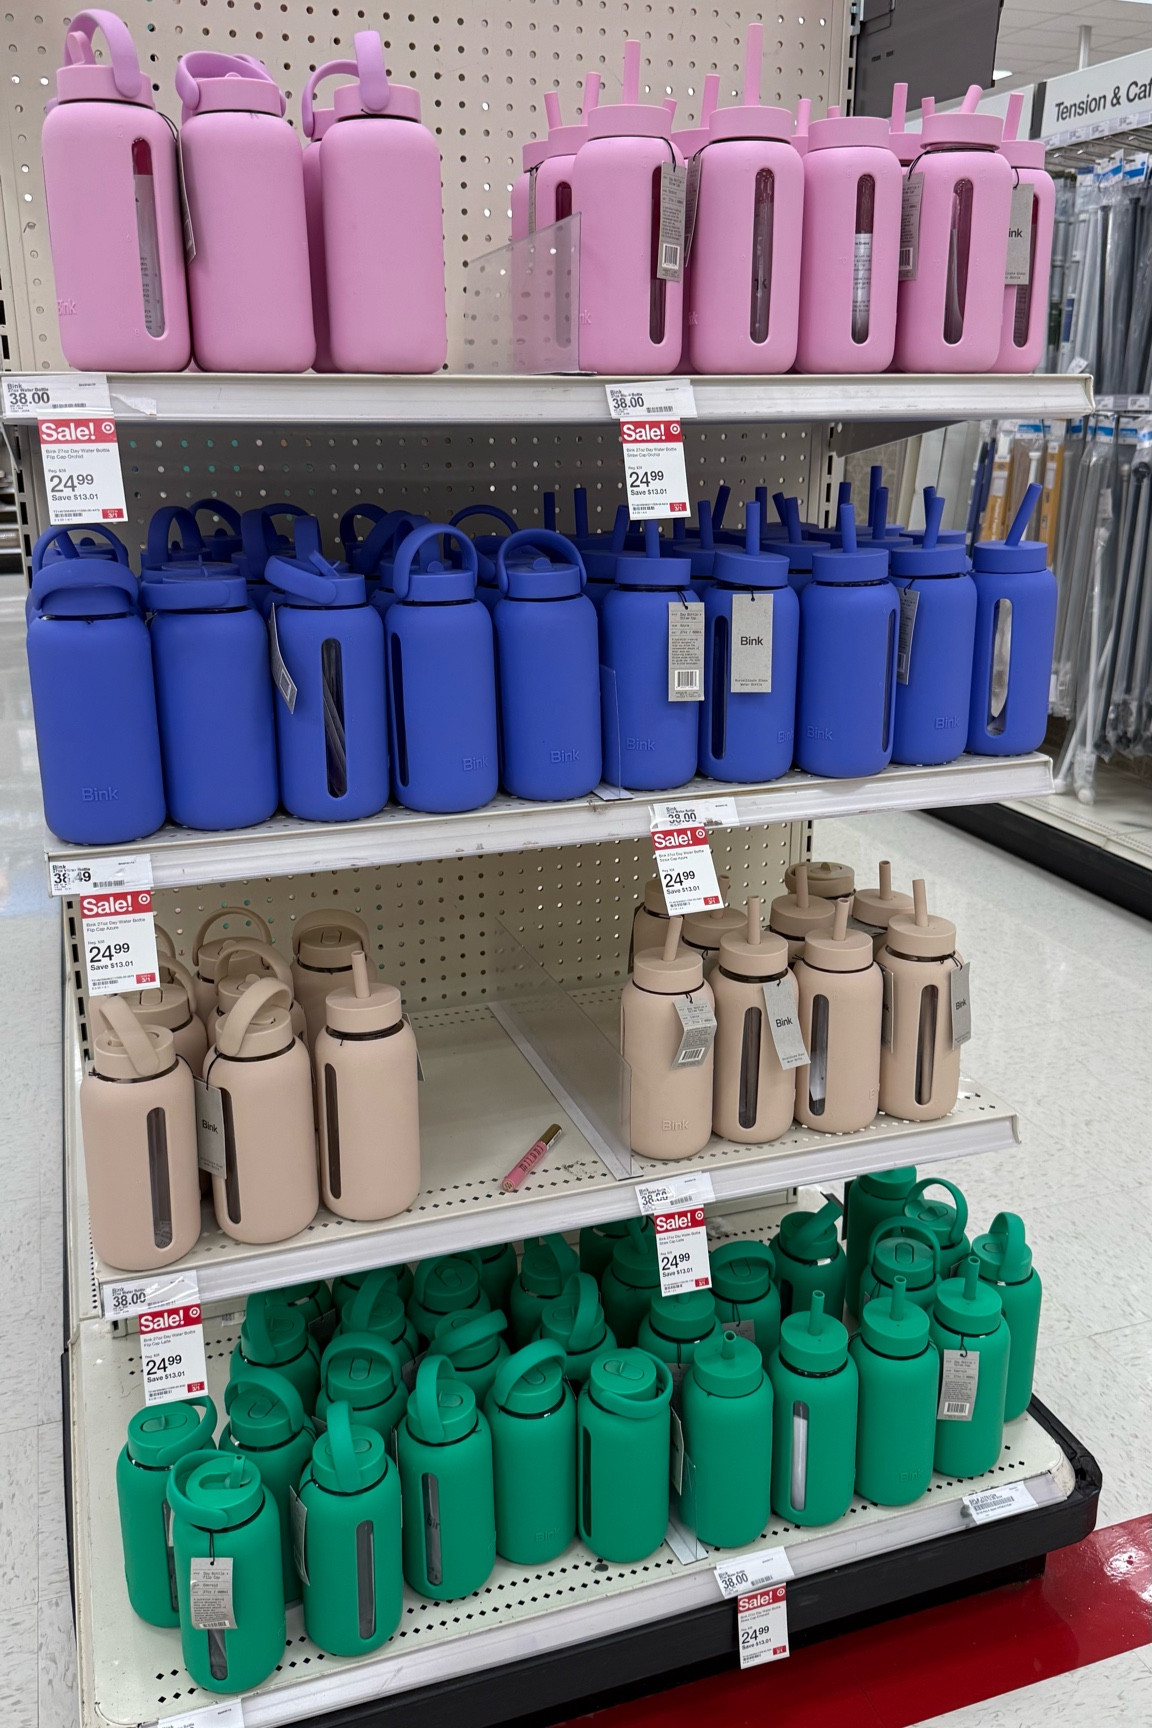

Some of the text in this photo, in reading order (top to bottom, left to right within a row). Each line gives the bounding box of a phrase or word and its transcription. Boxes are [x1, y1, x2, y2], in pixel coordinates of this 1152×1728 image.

[1055, 93, 1106, 122] Tension
[1111, 86, 1121, 107] &
[1008, 228, 1022, 238] ink
[10, 392, 50, 405] 38.00
[612, 396, 644, 409] 38.00
[41, 422, 96, 441] Sale!
[623, 424, 665, 440] Sale!
[740, 636, 763, 646] Bink
[935, 716, 960, 729] Bink
[807, 725, 832, 740] Bink
[627, 737, 656, 751] Bink
[462, 755, 488, 771] Bink
[551, 748, 580, 763] Bink
[82, 787, 119, 801] Bink
[654, 830, 692, 848] Sale!
[82, 895, 132, 915] Sale!
[775, 1016, 793, 1028] Bink
[202, 1120, 218, 1134] Bink
[661, 1120, 689, 1131] Bink
[656, 1212, 691, 1231] Sale!
[113, 1292, 146, 1308] 38.00
[140, 1310, 184, 1331] Sale!
[165, 1371, 185, 1379] $13.01
[722, 1573, 748, 1589] 38.00
[739, 1591, 773, 1611] Sale!
[756, 1638, 772, 1646] $13.01
